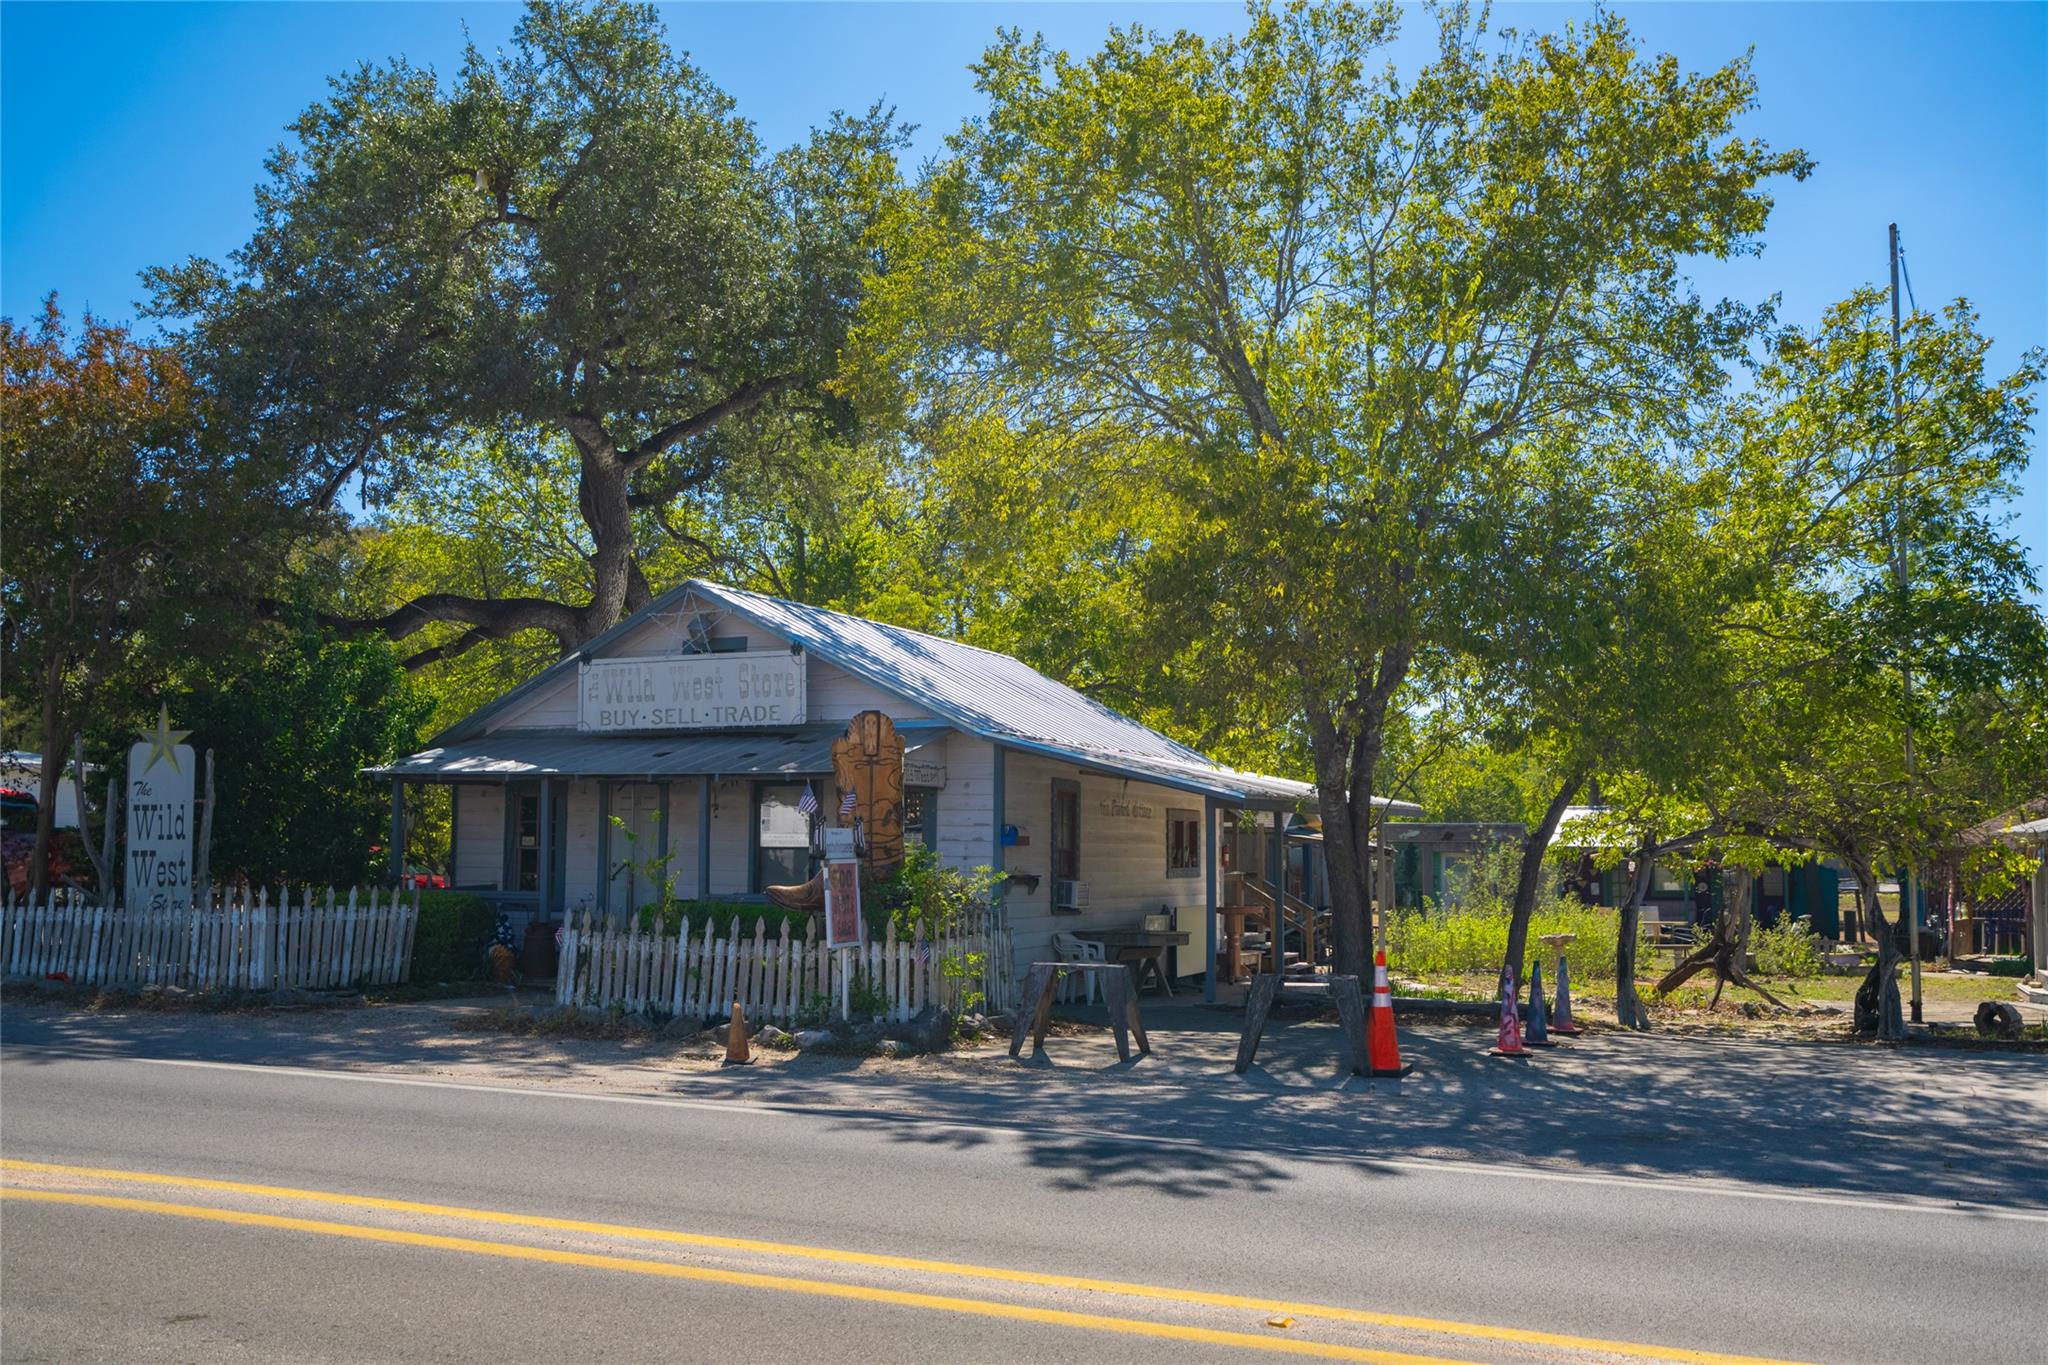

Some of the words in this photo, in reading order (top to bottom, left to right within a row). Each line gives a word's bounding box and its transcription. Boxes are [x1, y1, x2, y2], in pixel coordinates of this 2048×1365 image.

[602, 667, 656, 705] Wild
[669, 665, 724, 702] West
[737, 663, 794, 699] Store
[600, 708, 640, 727] BUY
[650, 706, 702, 725] SELL
[712, 704, 782, 723] TRADE
[133, 781, 152, 797] The
[133, 803, 186, 840] Wild
[131, 849, 188, 888] West
[152, 893, 185, 911] Stre
